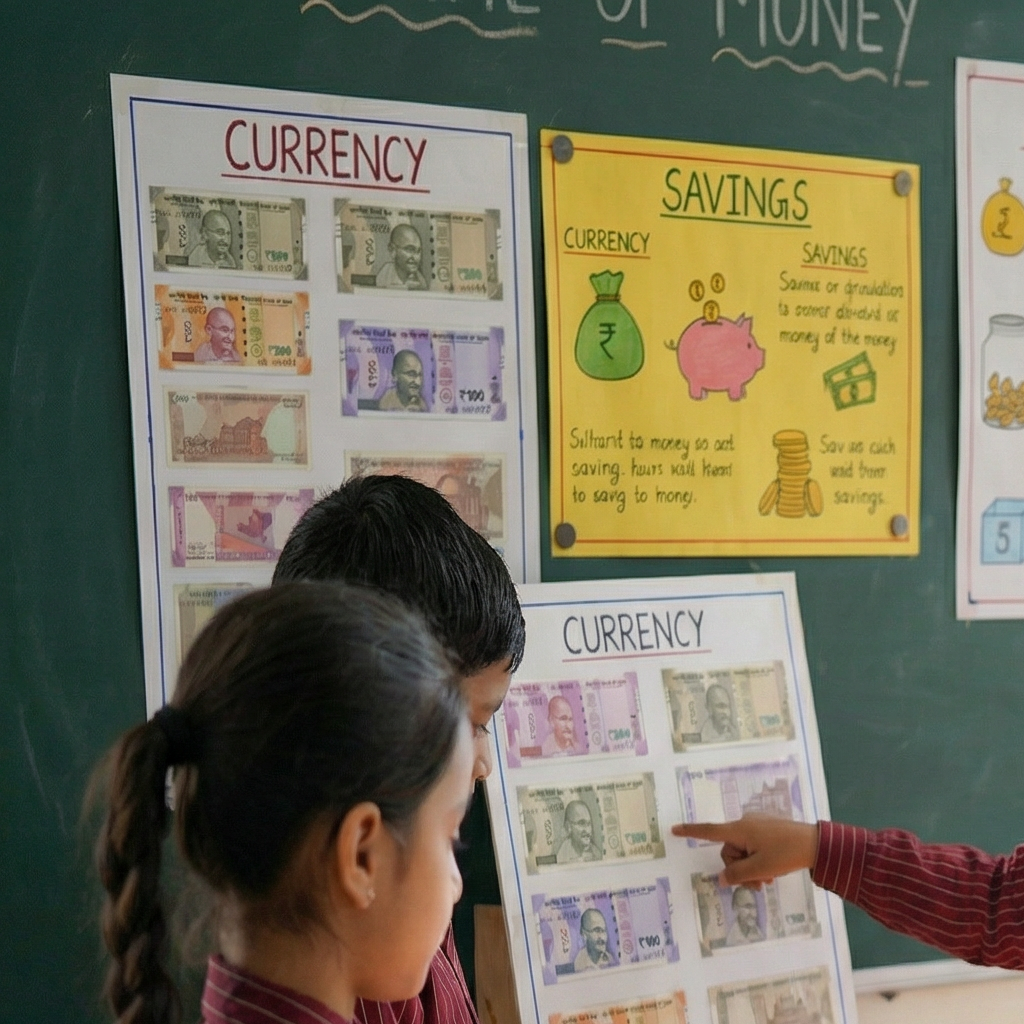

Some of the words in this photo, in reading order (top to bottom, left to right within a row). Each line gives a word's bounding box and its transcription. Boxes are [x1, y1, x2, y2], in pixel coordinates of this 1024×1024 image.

[224, 118, 428, 186] CURRENCY
[662, 167, 810, 223] SAVINGS
[564, 226, 650, 254] CURRENCY
[802, 241, 868, 268] SAVINGS
[629, 430, 644, 450] to
[572, 485, 586, 504] to
[634, 484, 648, 504] to
[995, 520, 1011, 555] 5
[562, 609, 705, 656] CURRENCY
